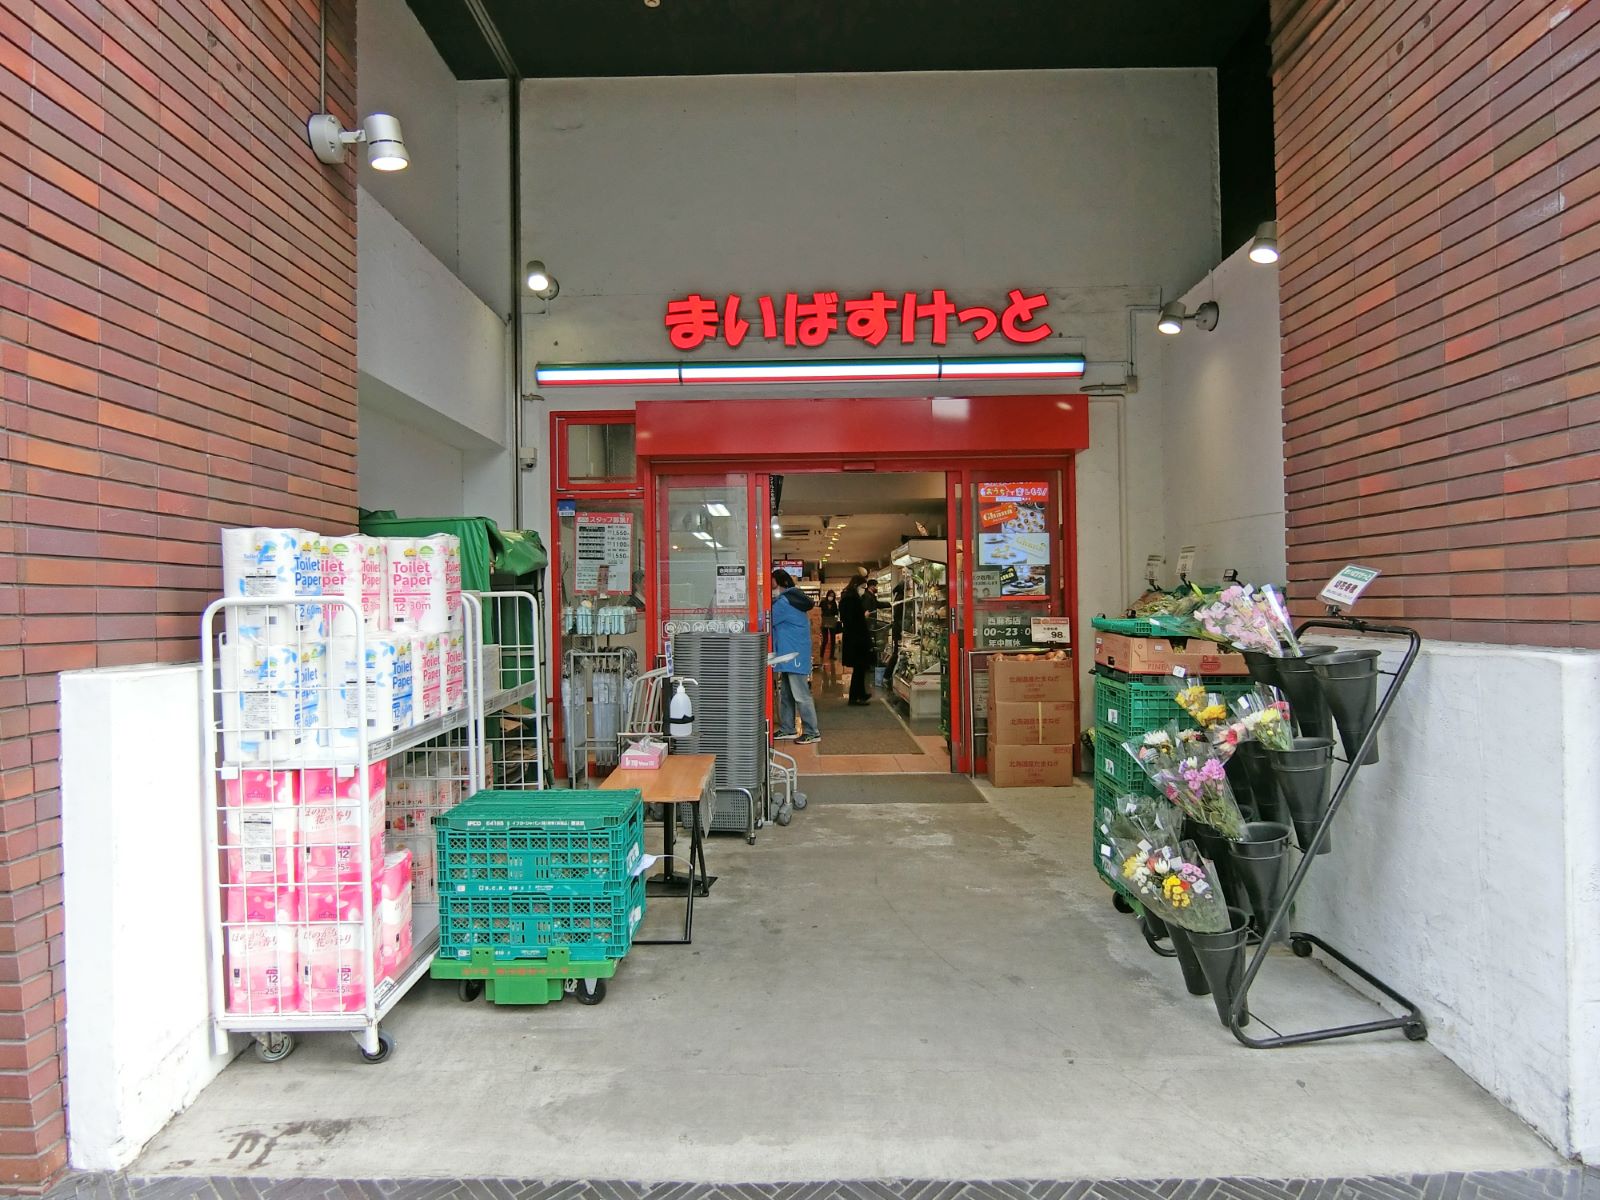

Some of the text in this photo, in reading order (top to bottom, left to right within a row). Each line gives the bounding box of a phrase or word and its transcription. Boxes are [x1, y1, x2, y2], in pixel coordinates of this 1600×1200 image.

[665, 288, 1052, 351] まいばすけっと
[983, 508, 1013, 521] Ghana
[294, 556, 320, 571] Toilet
[321, 559, 344, 573] ilet
[393, 561, 430, 573] Toilet
[322, 575, 346, 588] per
[394, 573, 432, 587] Paper
[396, 602, 431, 612] 12 30m
[1051, 631, 1064, 639] 98
[391, 660, 412, 675] Toilet
[338, 850, 349, 858] 12
[268, 975, 278, 983] 12
